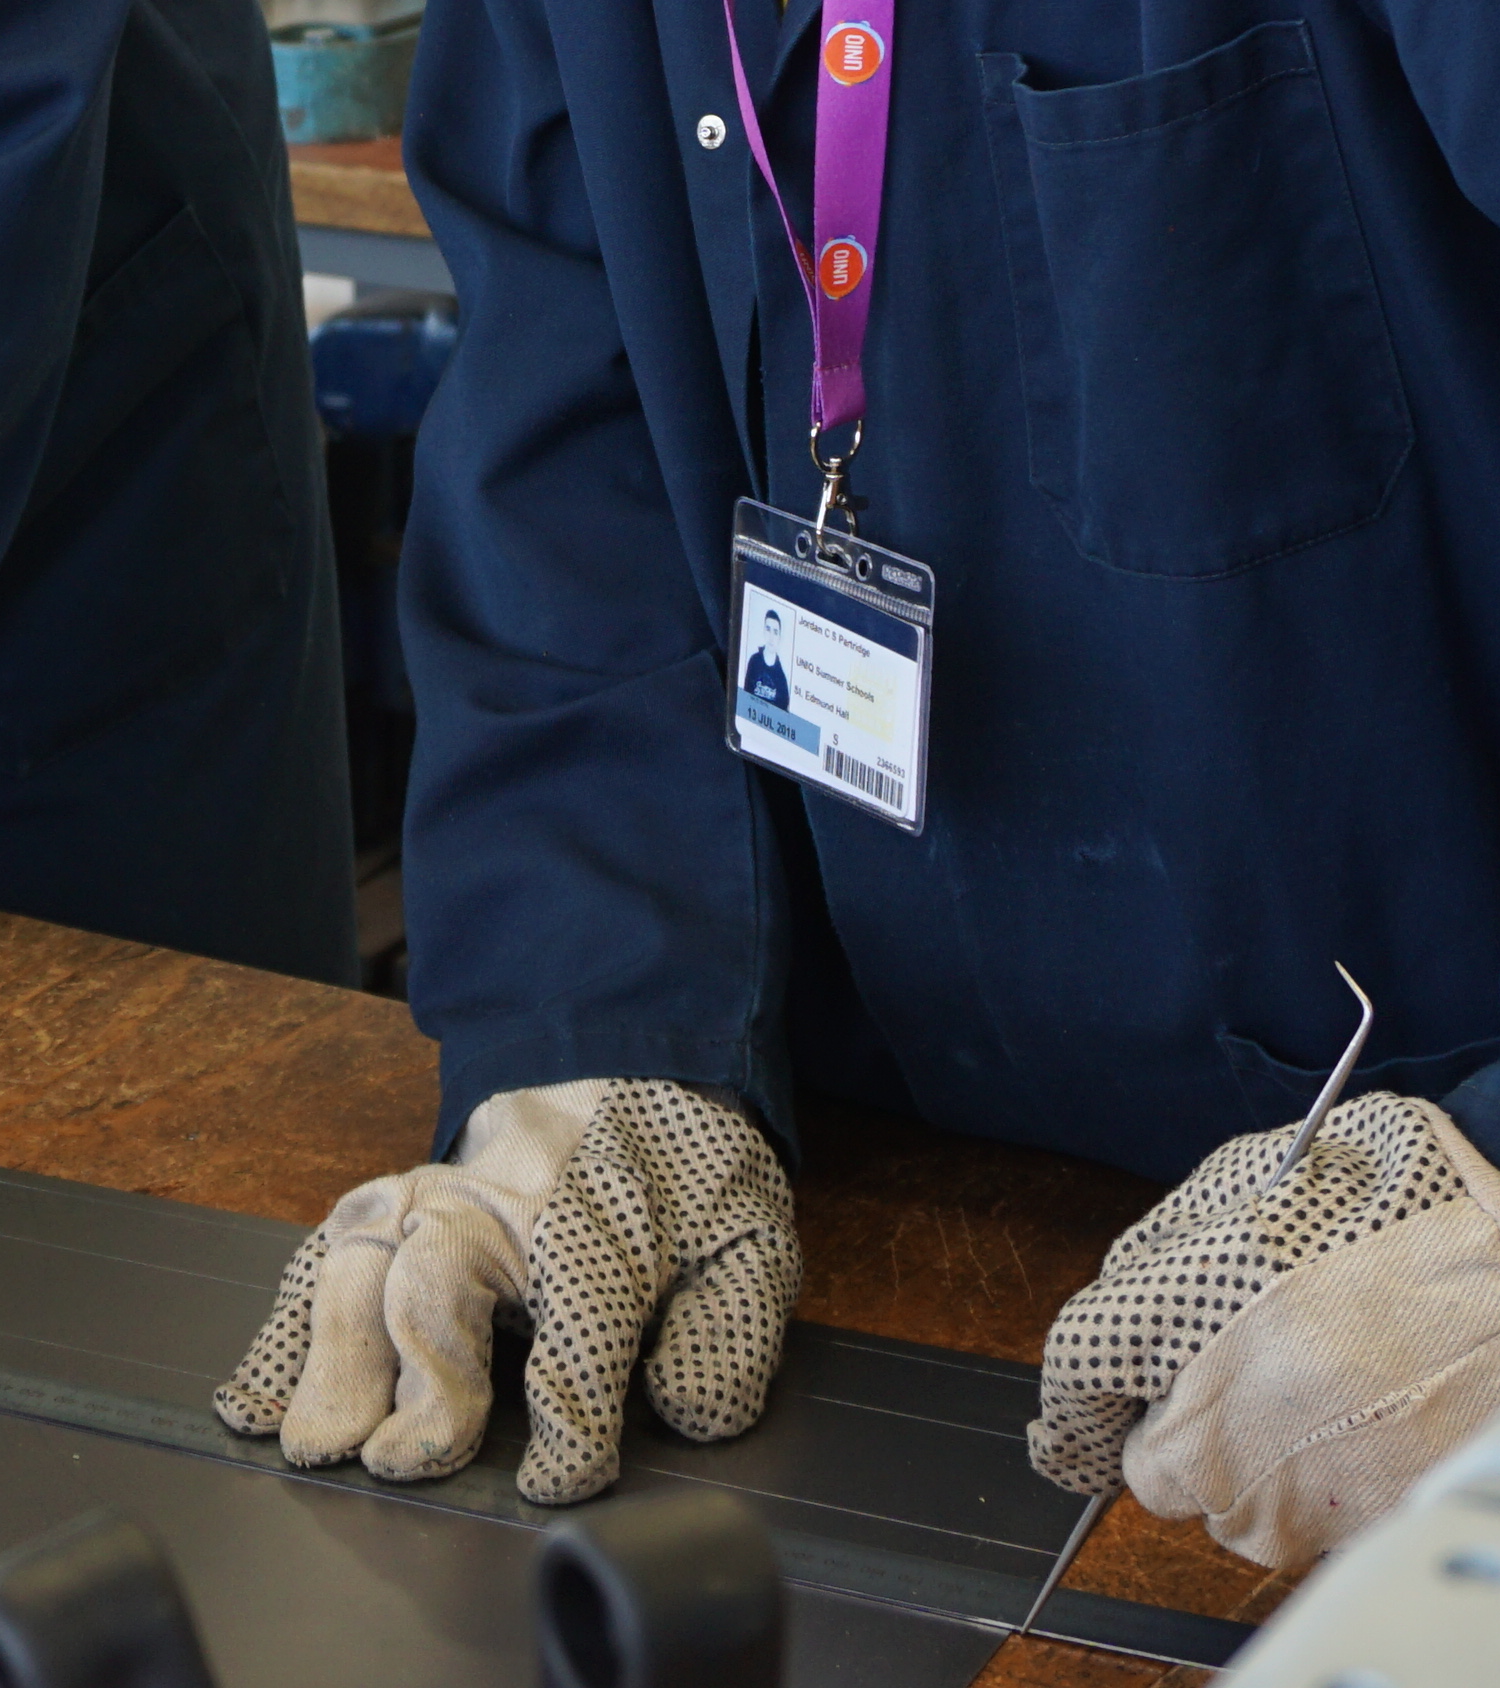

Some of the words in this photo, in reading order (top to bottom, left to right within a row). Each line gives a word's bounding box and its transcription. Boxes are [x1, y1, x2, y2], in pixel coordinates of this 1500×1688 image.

[843, 34, 866, 71] UNIQ
[833, 249, 850, 285] UNIQ
[798, 616, 822, 634] Jordan
[839, 634, 871, 658] Partridge
[796, 655, 814, 672] UNIQ
[816, 666, 844, 687] Summer
[846, 681, 875, 703] Schools
[805, 690, 835, 713] Edmund
[836, 705, 850, 720] Hall
[747, 707, 757, 721] 13
[758, 713, 774, 730] JUL
[777, 722, 796, 740] 2018
[833, 733, 839, 746] S
